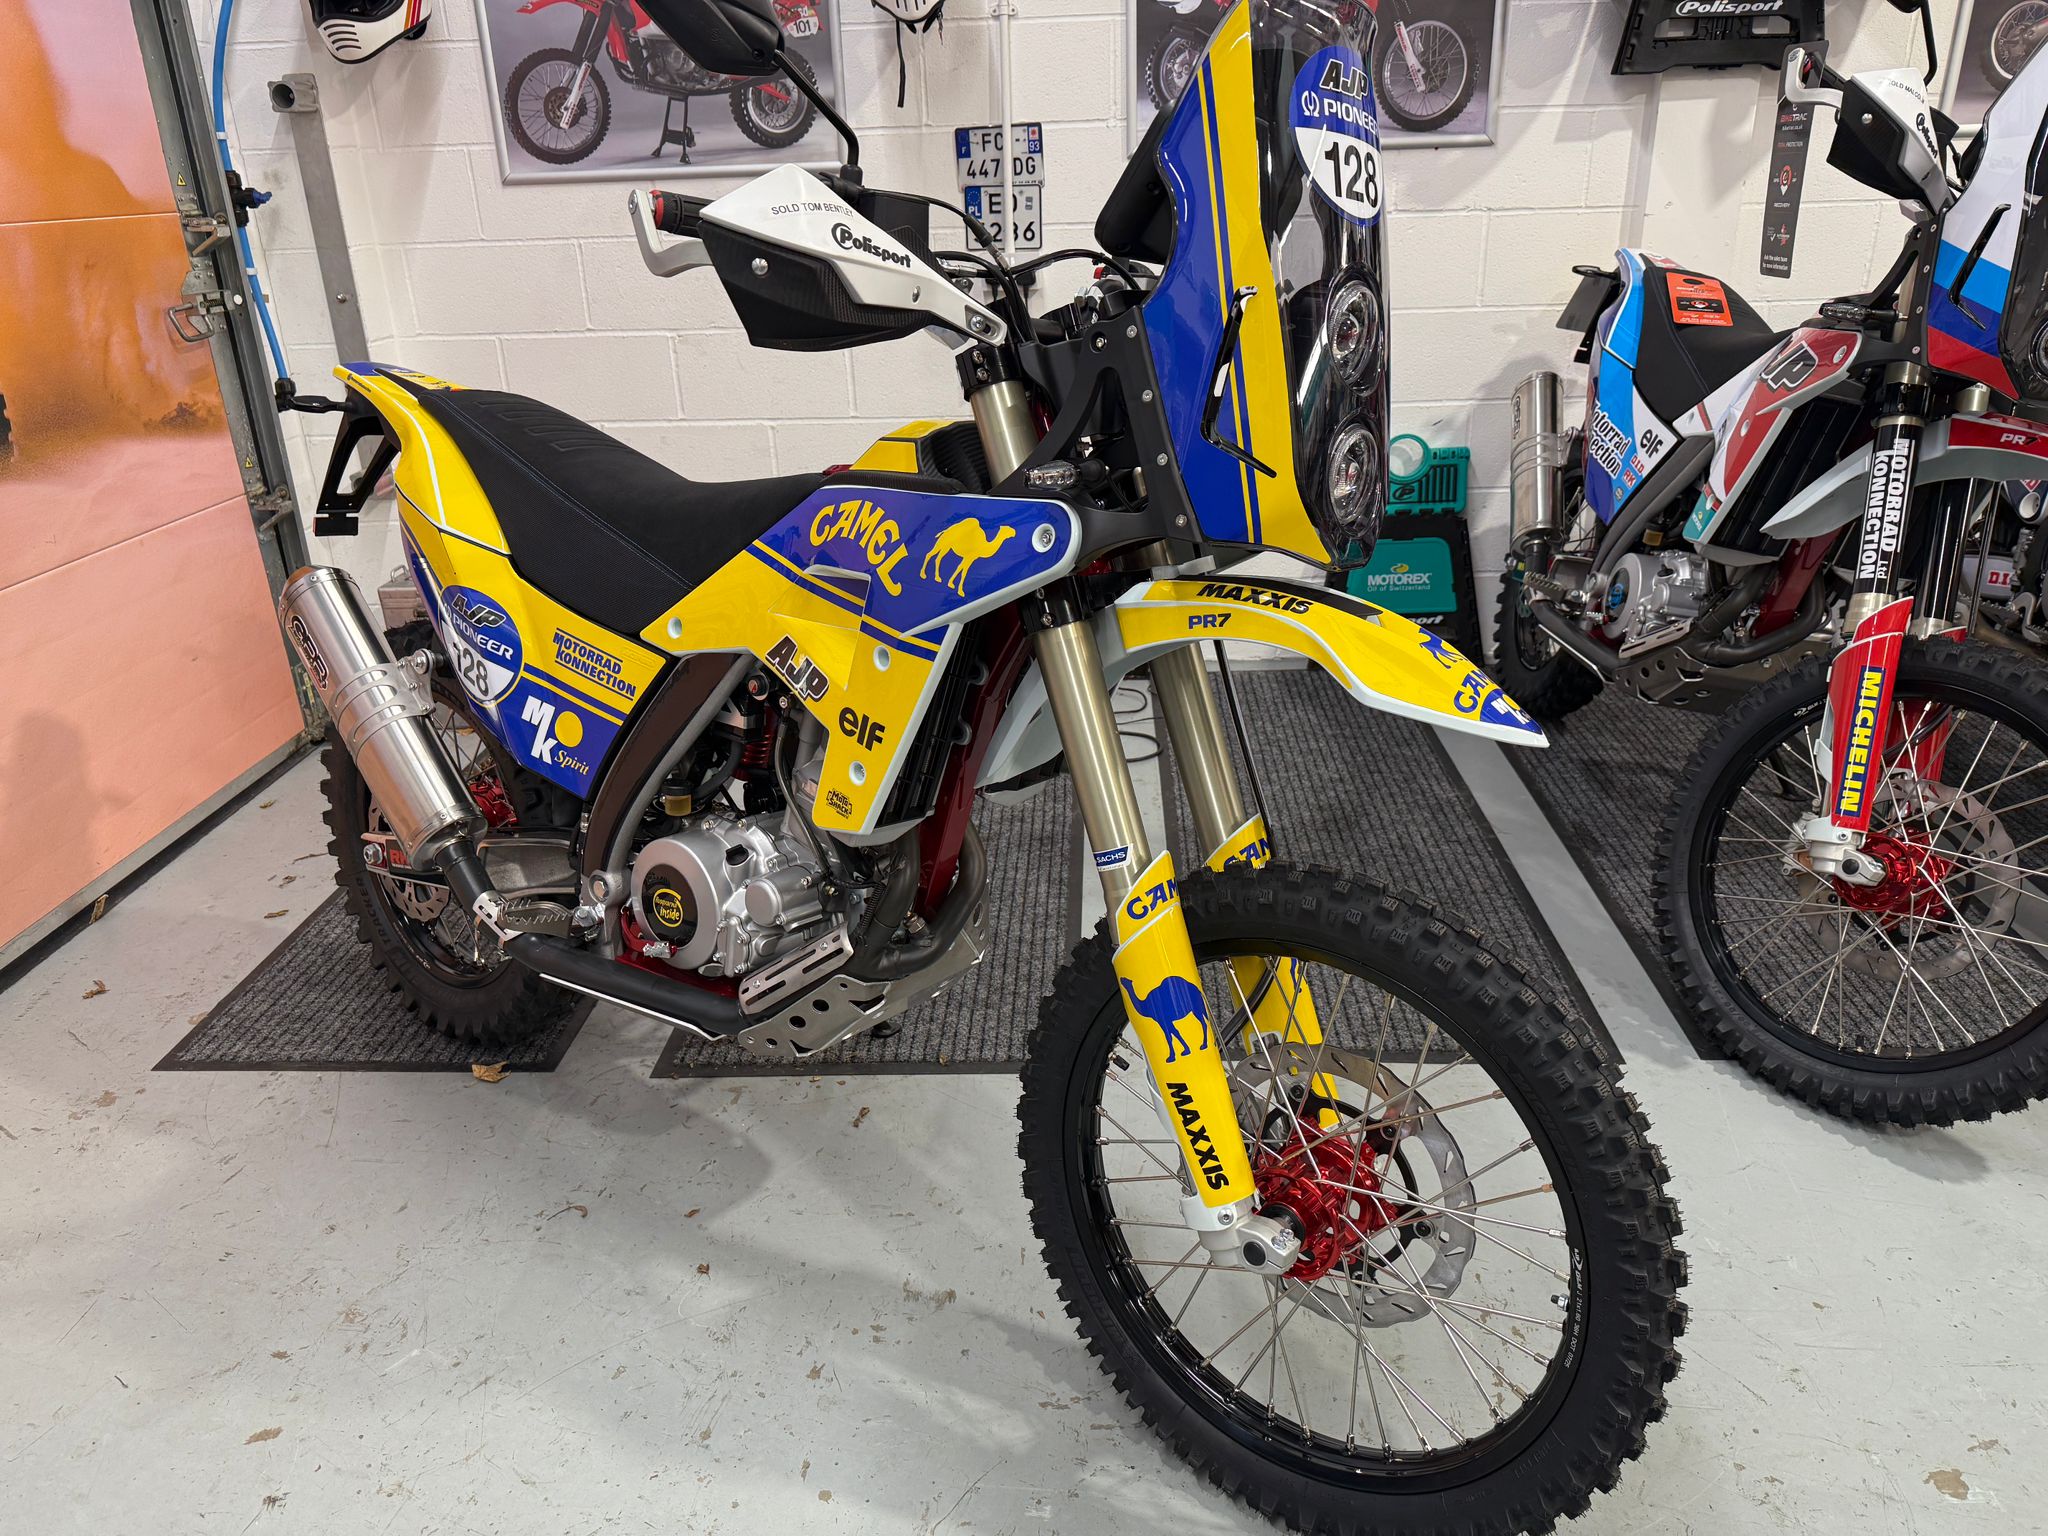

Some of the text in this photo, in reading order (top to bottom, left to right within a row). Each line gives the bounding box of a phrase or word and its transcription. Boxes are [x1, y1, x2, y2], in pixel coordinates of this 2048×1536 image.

[1675, 0, 1784, 16] Polisport
[793, 19, 812, 34] 101
[1319, 58, 1370, 100] AJP
[1323, 98, 1378, 136] PIONEE
[961, 146, 967, 154] F
[1029, 141, 1040, 152] 93
[966, 156, 1036, 179] 447 DG
[1324, 141, 1378, 208] 128
[771, 202, 854, 218] SOLD TOM BENTLEY
[968, 207, 981, 217] PL
[831, 223, 911, 268] Polisport
[1640, 429, 1664, 458] elf
[2000, 432, 2039, 446] PR7
[1880, 438, 1910, 553] MOTORRAD
[1860, 450, 1889, 579] KONNECTION
[809, 499, 909, 597] CAMEL
[1367, 573, 1430, 586] MOTOREX
[1876, 560, 1889, 579] Ltd
[451, 593, 507, 628] AJP
[1196, 584, 1314, 615] MAXXIS
[1188, 612, 1232, 630] PR7
[452, 615, 514, 661] PIONEER
[552, 631, 622, 675] MOTORRAD
[452, 640, 489, 697] 128
[556, 649, 637, 697] KONNECTION
[765, 634, 830, 702] AJP
[838, 706, 886, 752] elf
[1840, 671, 1882, 812] MICHELIN
[554, 750, 590, 776] Spirit
[1096, 851, 1126, 864] SACHS
[1166, 1082, 1230, 1191] MAXXIS
[1569, 1337, 1578, 1352] DOT
